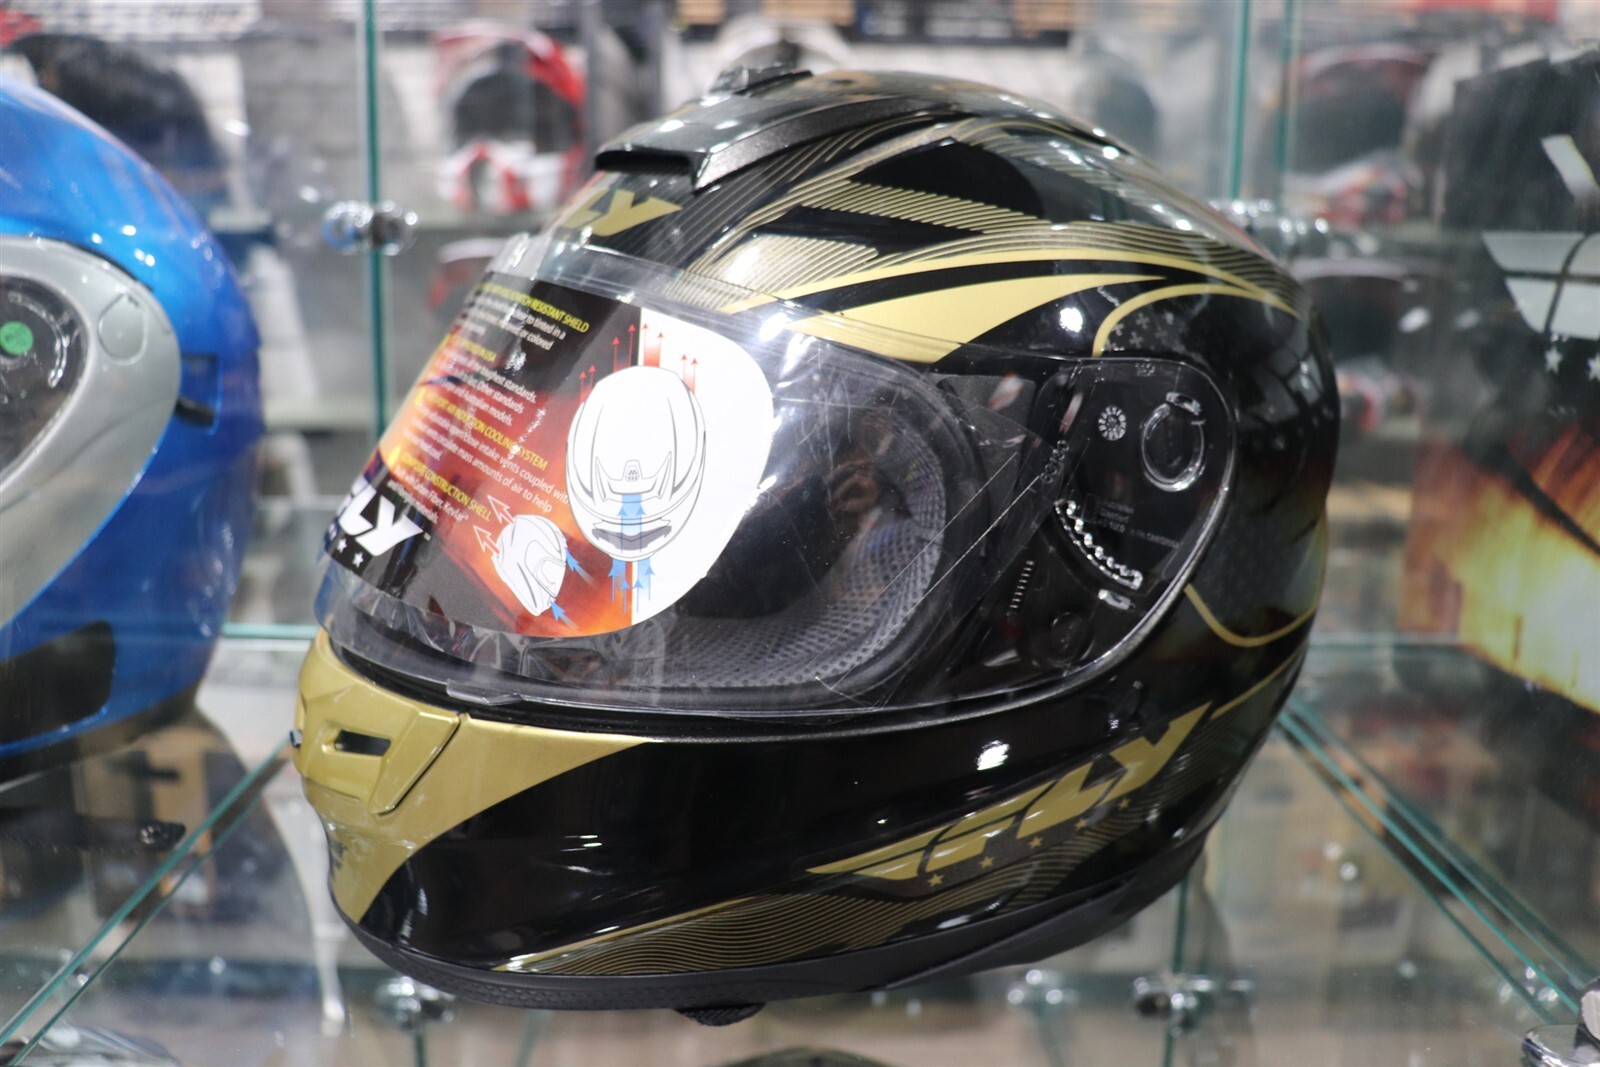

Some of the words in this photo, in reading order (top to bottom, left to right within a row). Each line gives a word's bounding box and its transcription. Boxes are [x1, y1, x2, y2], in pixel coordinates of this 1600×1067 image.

[558, 186, 683, 237] LY
[530, 298, 566, 321] RESISTANT
[564, 312, 590, 333] SHIELD
[532, 316, 556, 334] tinted
[527, 331, 555, 350] colored
[478, 442, 500, 461] intake
[500, 456, 520, 474] vents
[520, 469, 555, 494] coupled
[472, 458, 503, 482] amounts
[502, 477, 515, 488] of
[511, 483, 524, 495] air
[522, 489, 533, 501] to
[532, 493, 553, 514] help
[467, 498, 492, 522] SHELL
